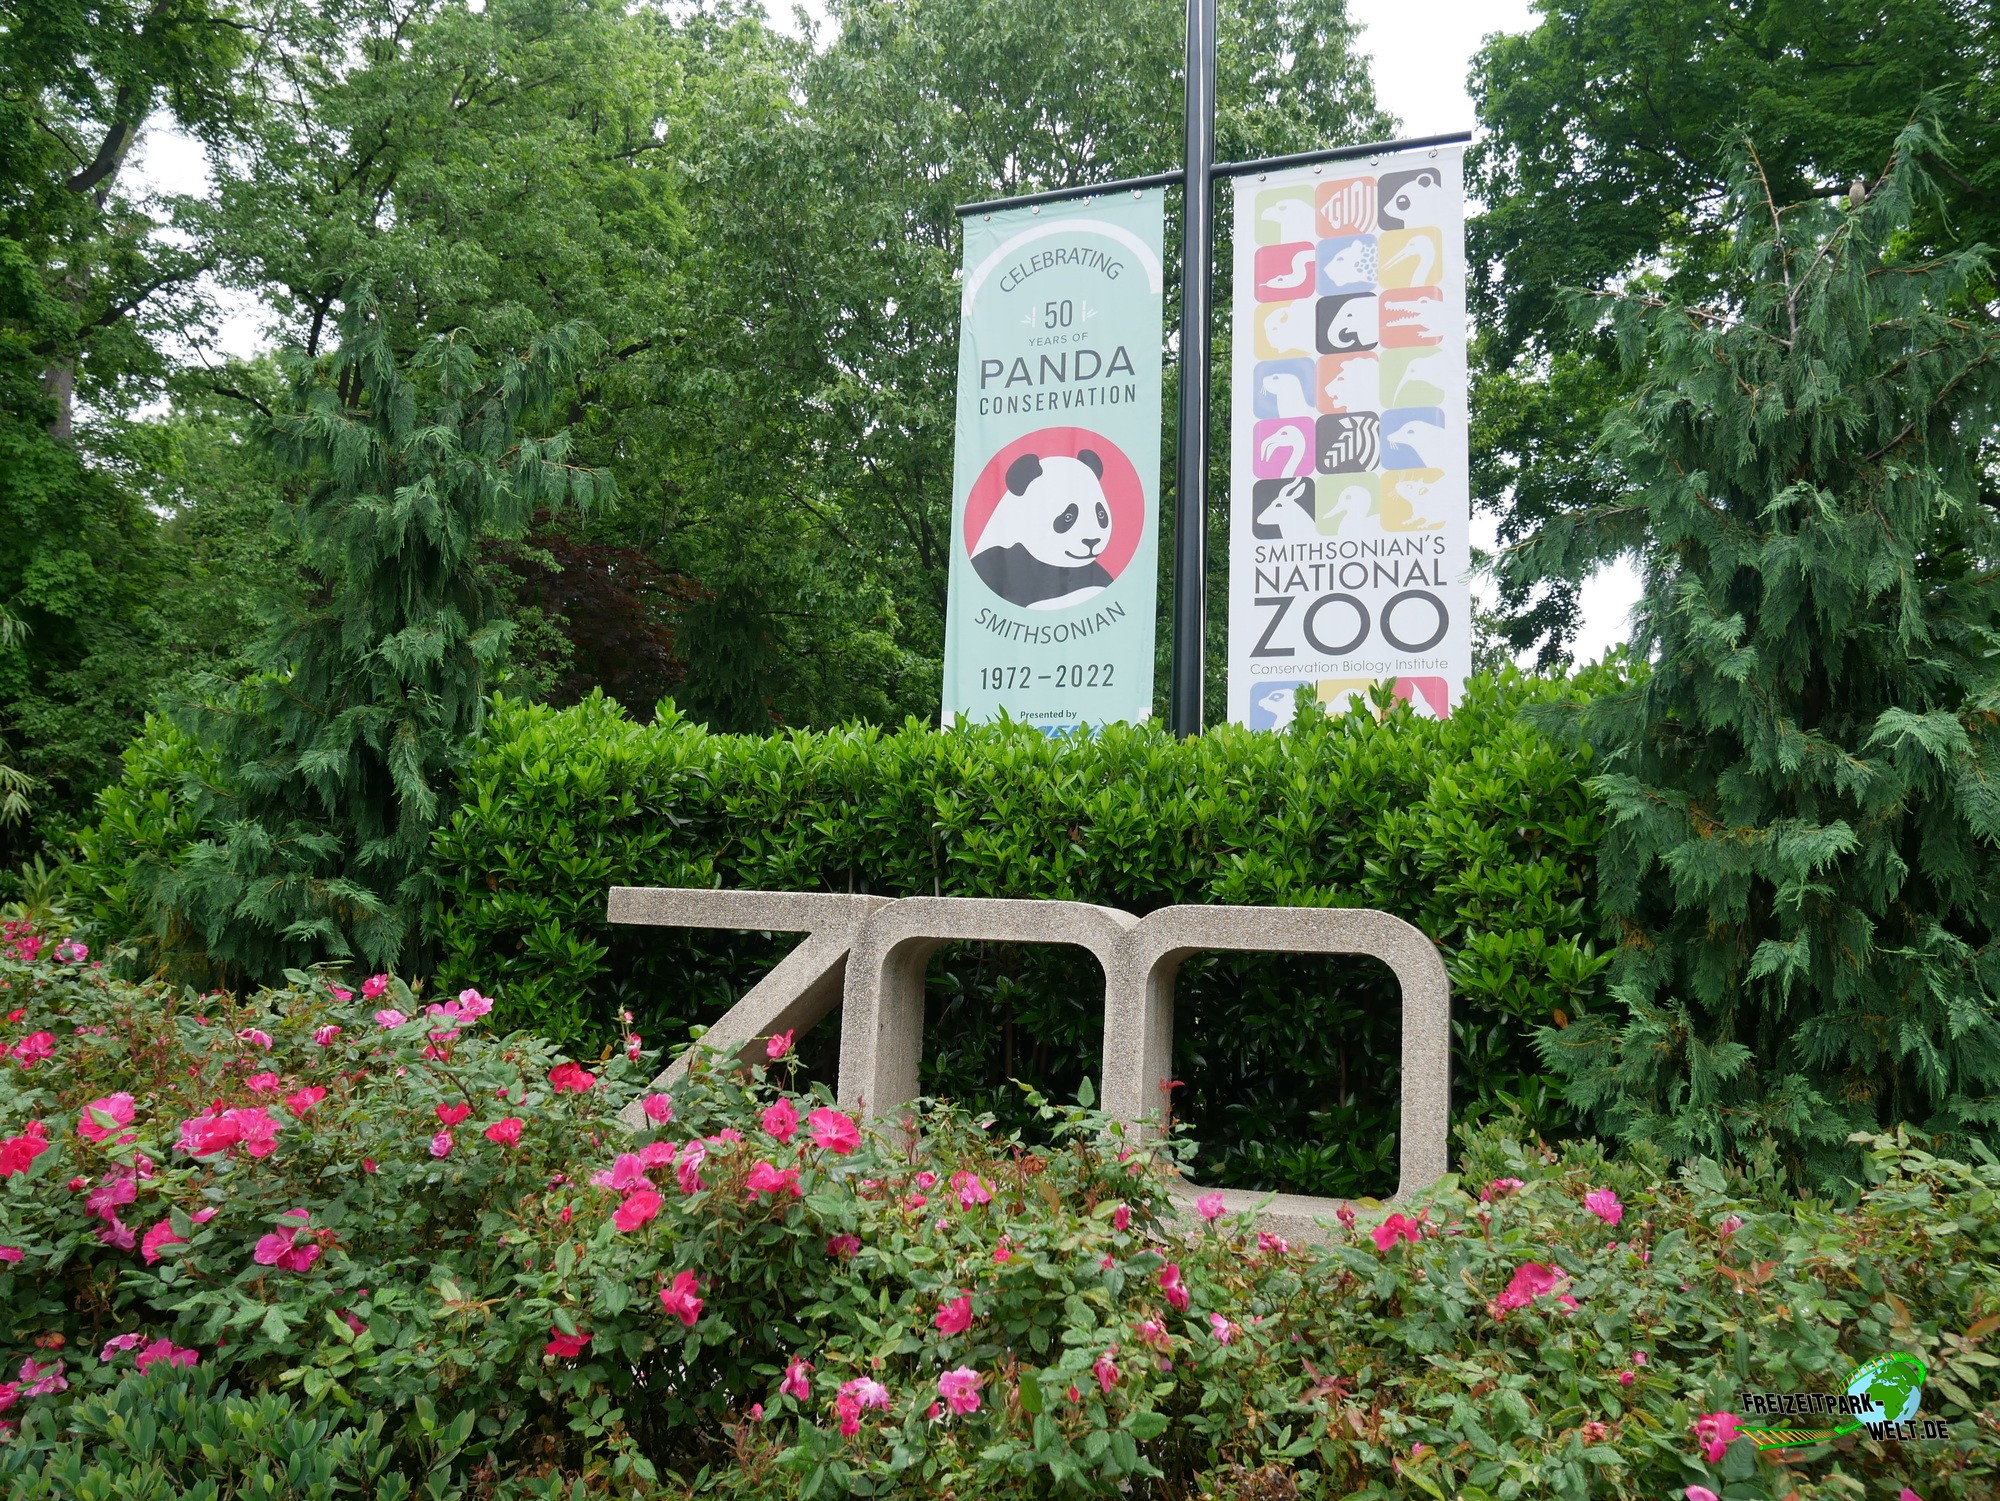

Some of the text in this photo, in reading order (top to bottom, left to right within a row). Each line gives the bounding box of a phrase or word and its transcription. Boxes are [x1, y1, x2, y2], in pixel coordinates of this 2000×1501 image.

[999, 247, 1124, 293] CELEBRATING
[1044, 299, 1073, 329] 50
[1028, 332, 1089, 347] YEARS OF
[980, 345, 1136, 390] PANDA
[979, 384, 1136, 416] CONSERVATION
[1254, 534, 1446, 563] SMITHSONIAN'S
[1254, 557, 1448, 594] NATIONAL
[974, 600, 1126, 645] SMITHSONIAN
[1249, 589, 1450, 658] ZOO
[1250, 657, 1449, 675] Conservation Biology Institute
[1020, 710, 1077, 719] Presented by
